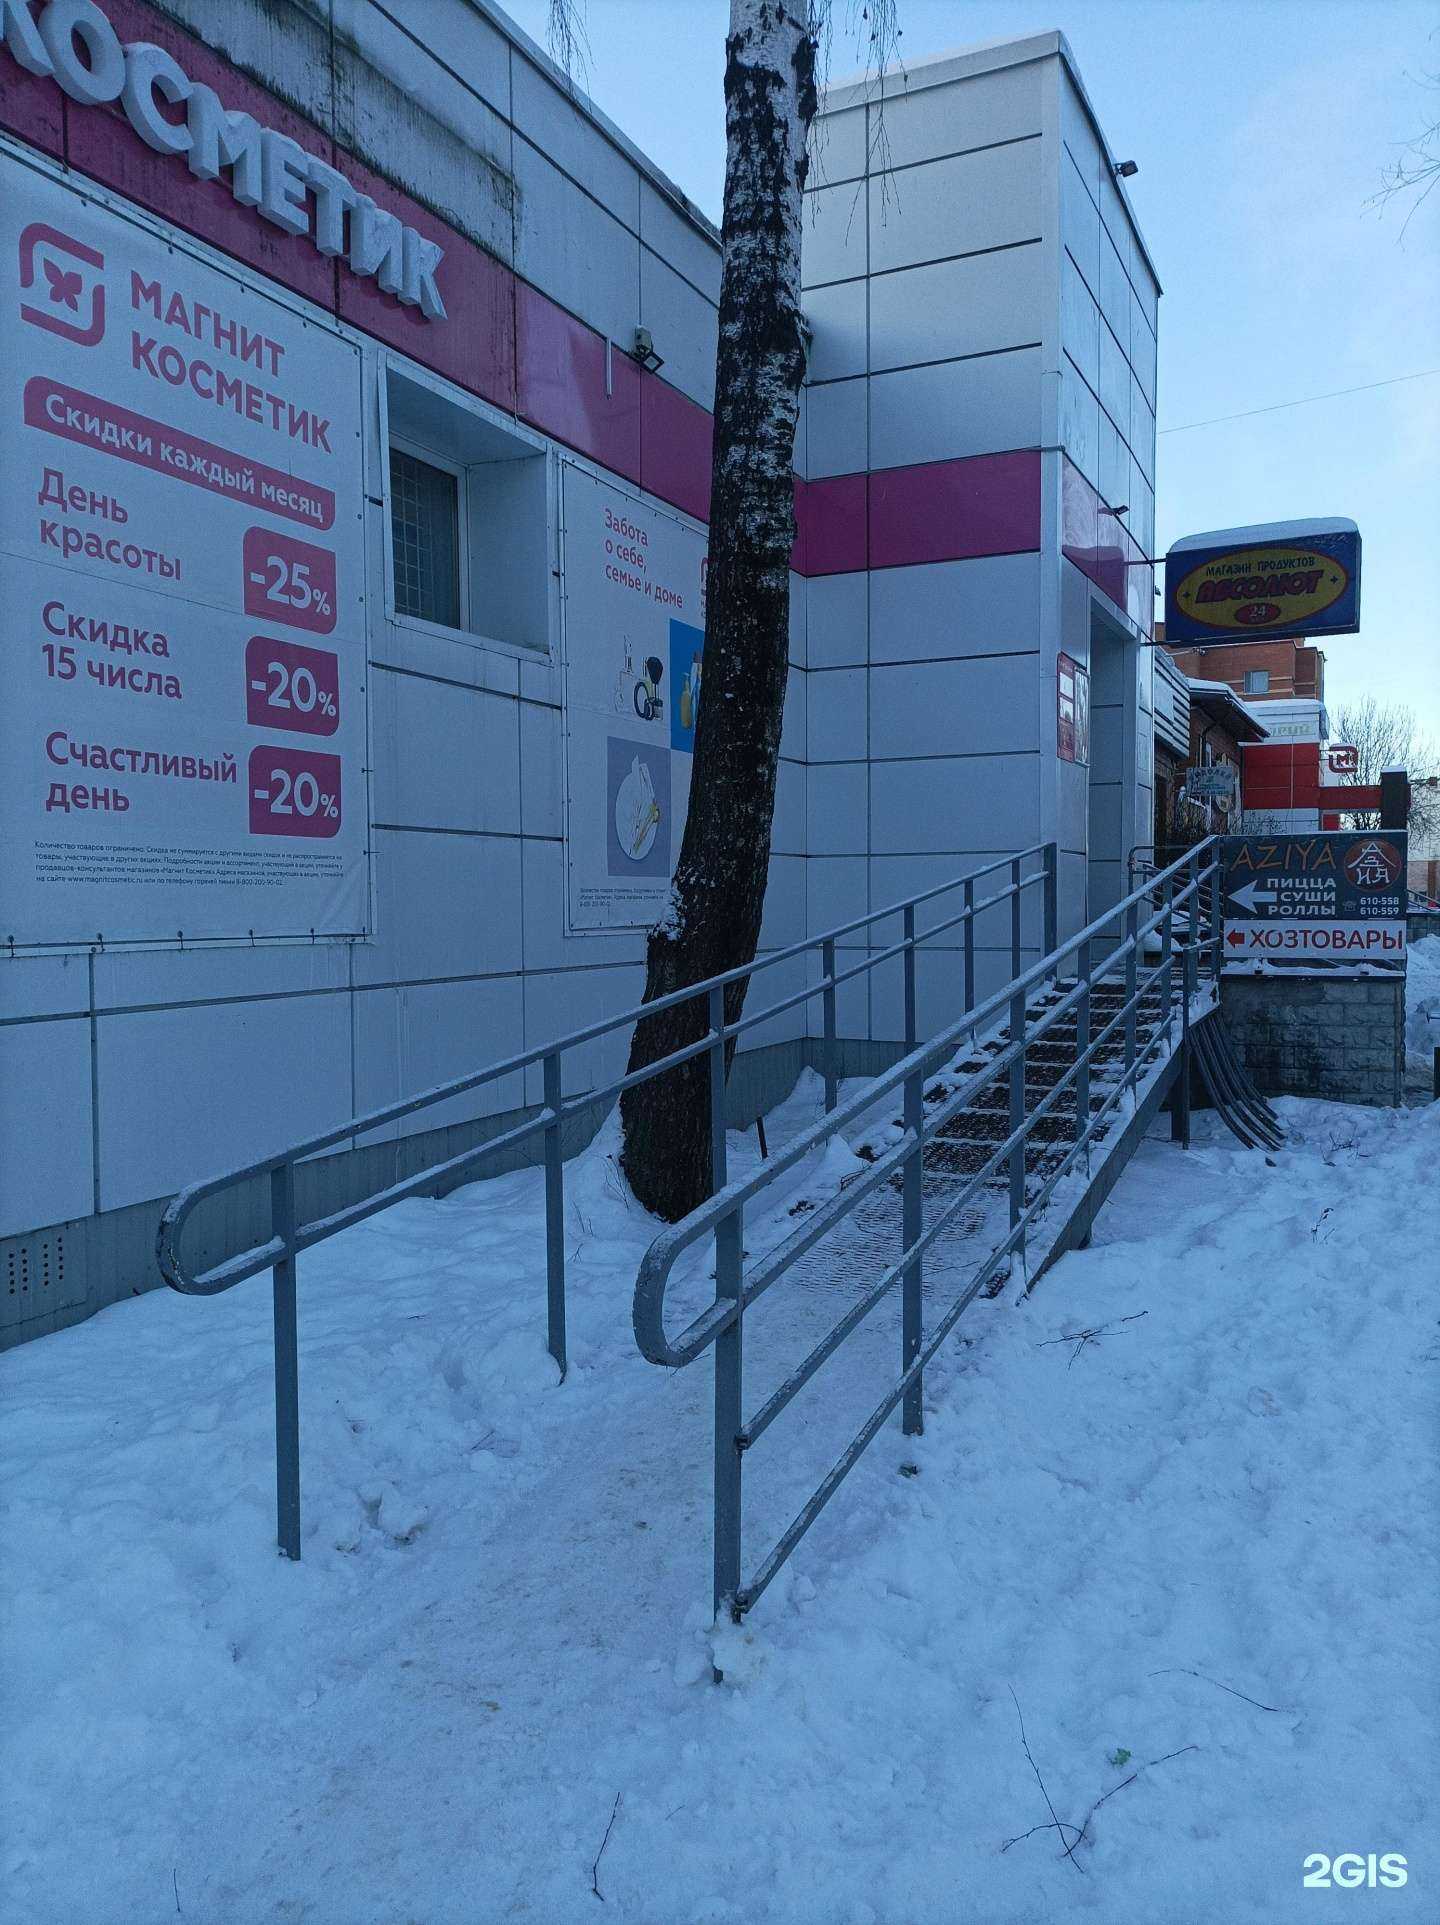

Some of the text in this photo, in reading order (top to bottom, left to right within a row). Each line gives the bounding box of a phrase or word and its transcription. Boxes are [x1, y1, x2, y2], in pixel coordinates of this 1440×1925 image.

[131, 270, 285, 377] МАГНИТ
[131, 330, 332, 454] КОСМЕТИК
[45, 394, 323, 523] Скидки каждый месяц
[38, 467, 128, 524] День
[40, 519, 181, 580] красоты
[605, 508, 648, 547] Забота
[605, 540, 647, 574] о себе,
[1206, 556, 1316, 577] МАГАЗИН ПРОДУКТОВ
[250, 555, 331, 616] -25%
[605, 564, 641, 591] семье
[644, 582, 652, 596] и
[654, 585, 683, 608] доме
[42, 601, 170, 658] Скидка
[42, 644, 182, 699] 15 числа
[251, 661, 337, 717] -20%
[45, 731, 237, 783] Счастливый
[45, 782, 130, 813] день
[254, 768, 339, 818] -20%
[1230, 840, 1337, 871] AZIYA
[1267, 878, 1337, 890] ПИЦЦА
[1280, 892, 1336, 902] СУШИ
[1360, 897, 1399, 906] 610-558
[1268, 905, 1336, 916] РОЛЛЫ
[1360, 907, 1399, 916] 610-559
[1249, 929, 1403, 950] ХОЗТОВАРЫ
